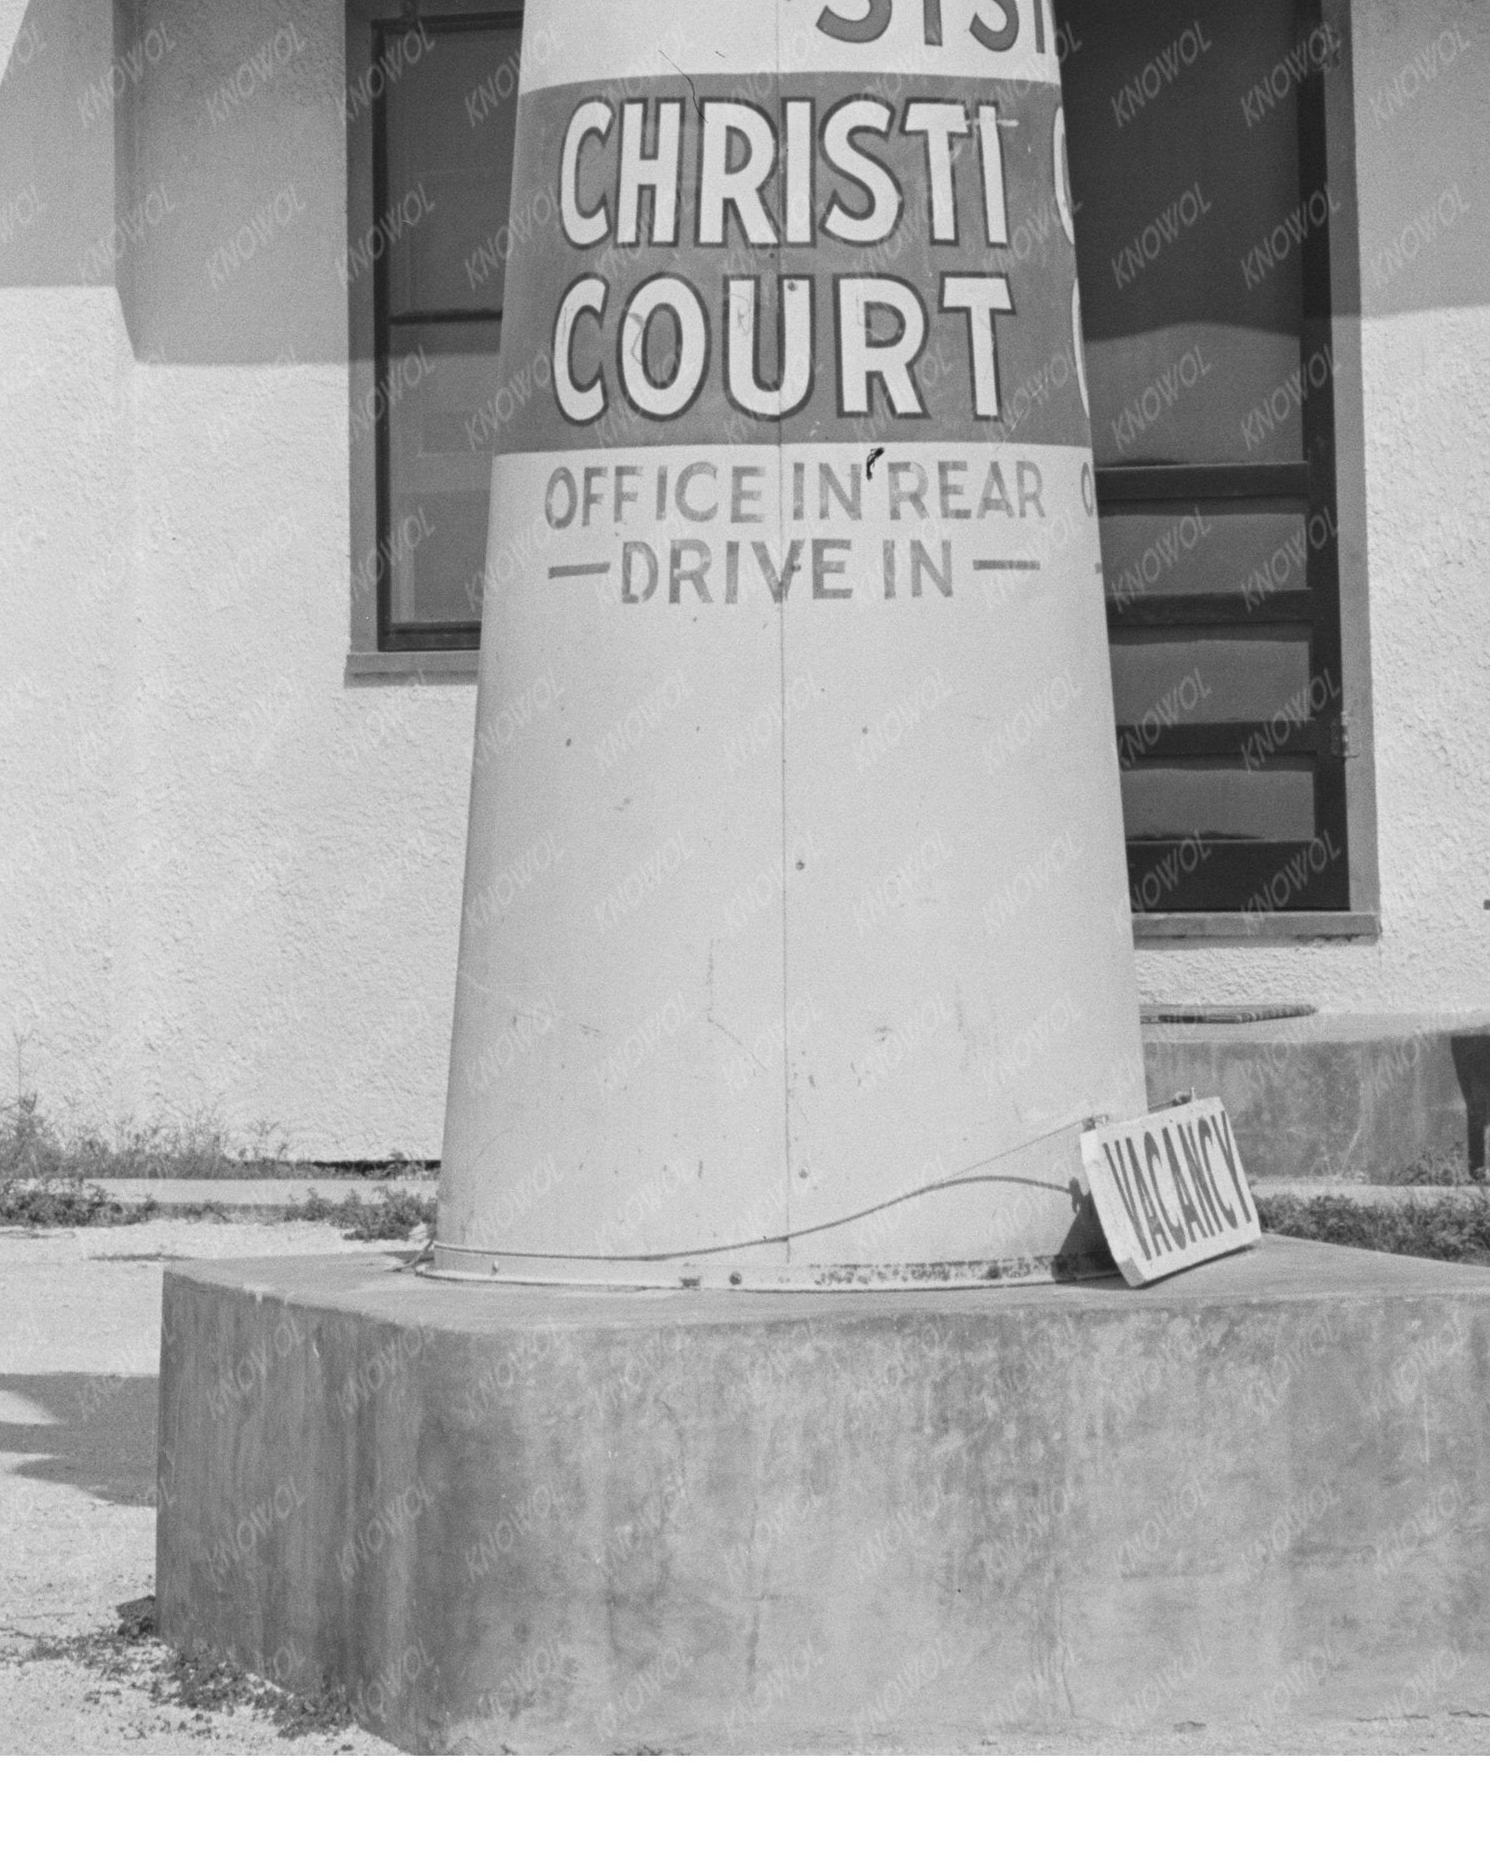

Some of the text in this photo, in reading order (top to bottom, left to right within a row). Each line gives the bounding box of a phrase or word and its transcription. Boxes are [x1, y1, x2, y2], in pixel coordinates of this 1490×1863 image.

[561, 96, 1010, 248] CHRISTI
[551, 272, 1016, 425] COURT
[545, 461, 764, 529] OFFICE
[792, 461, 862, 522] IN
[890, 460, 1044, 521] REAR
[620, 538, 953, 604] DRIVE IN
[1102, 1110, 1253, 1261] VACANCY
